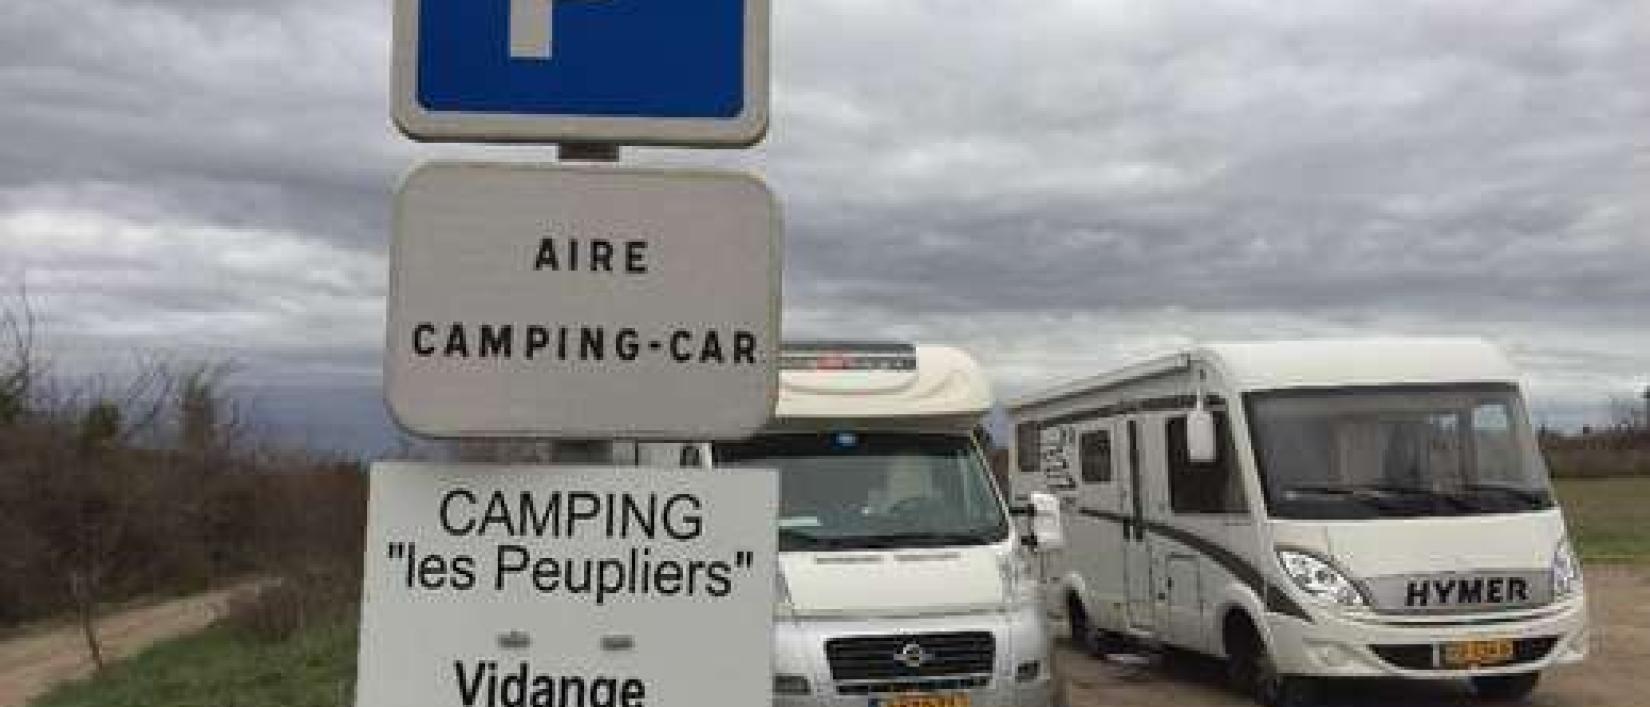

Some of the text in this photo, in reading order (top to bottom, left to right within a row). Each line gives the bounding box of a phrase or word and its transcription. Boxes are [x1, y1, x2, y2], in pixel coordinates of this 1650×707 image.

[534, 238, 648, 274] AIRE
[412, 323, 758, 364] CAMPING-CAR
[439, 489, 704, 541] CAMPING
[388, 541, 754, 605] "les Peupliers"
[1406, 577, 1528, 606] HYMER
[453, 660, 646, 707] Vidange
